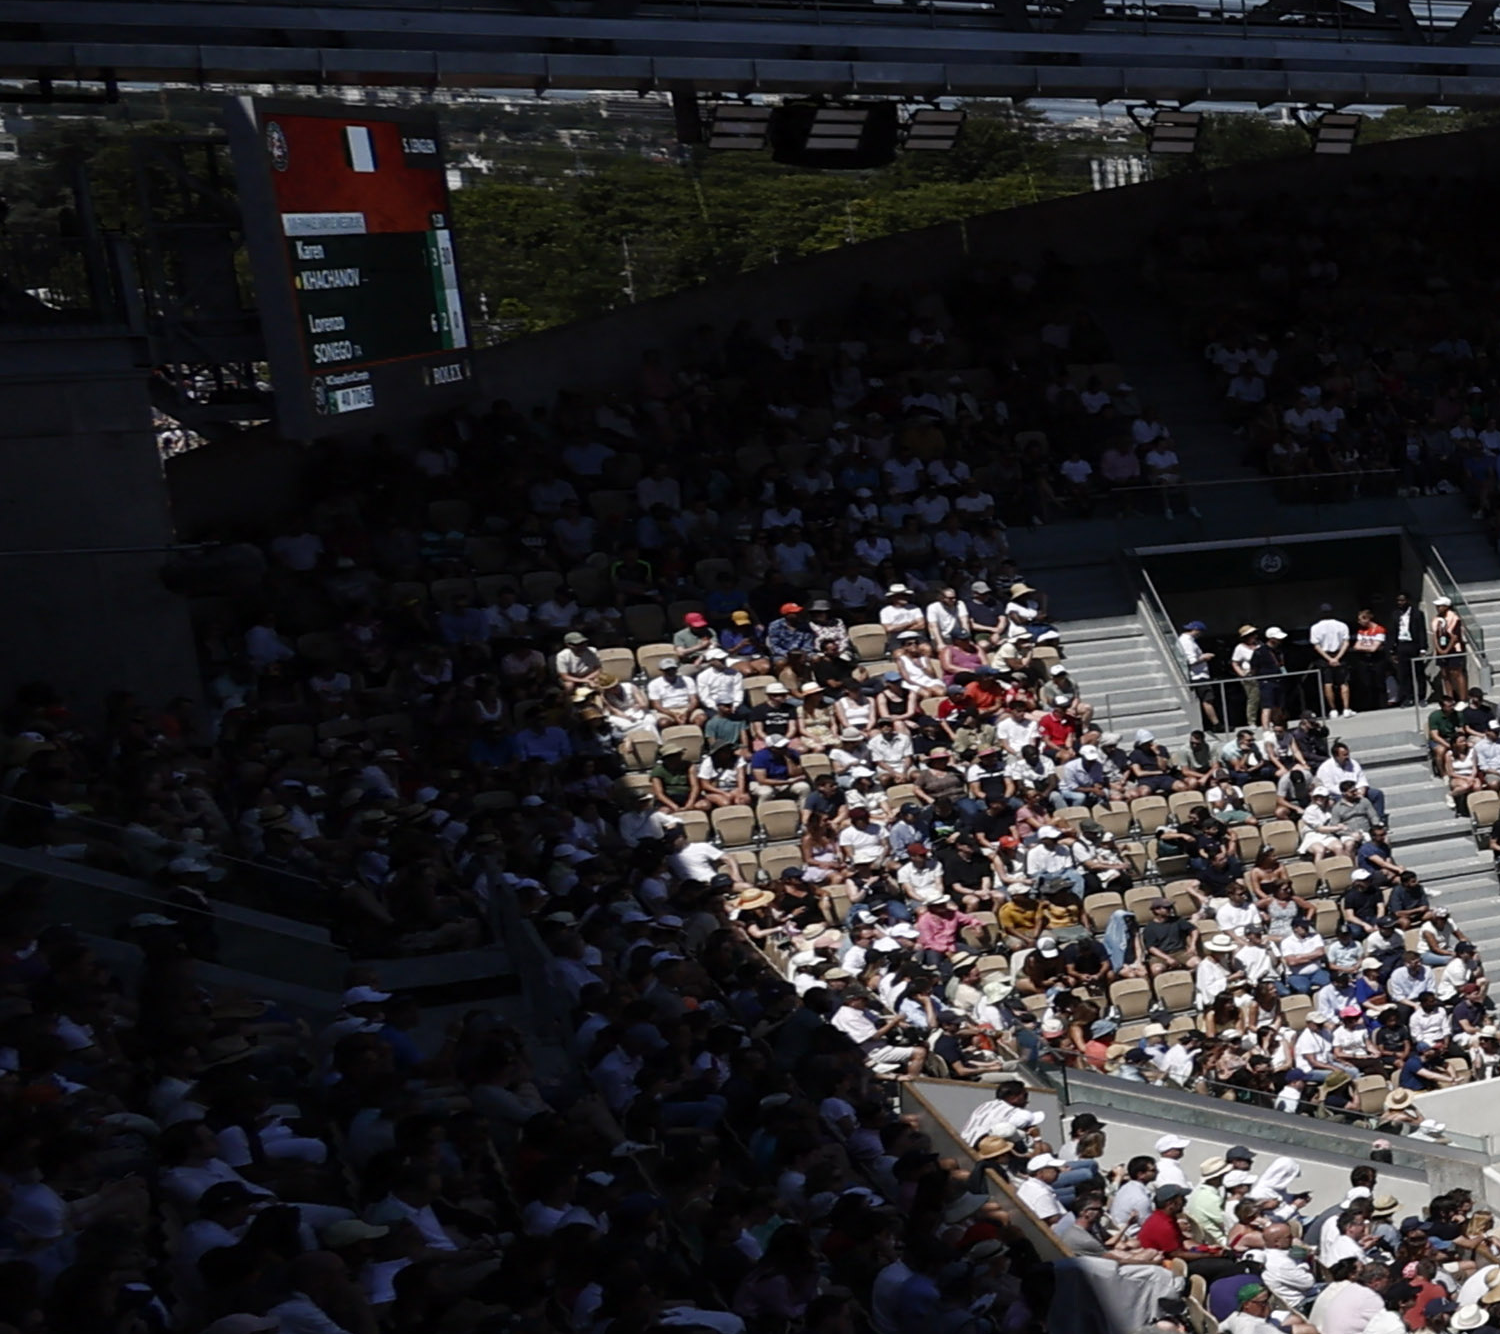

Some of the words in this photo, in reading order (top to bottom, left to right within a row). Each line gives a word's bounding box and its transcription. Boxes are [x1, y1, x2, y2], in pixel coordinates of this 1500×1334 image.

[296, 240, 324, 260] Karen
[301, 268, 360, 291] KHACHANOV
[308, 313, 345, 334] Lorenzo
[441, 311, 449, 332] 2
[314, 340, 352, 364] SONEGO
[433, 363, 462, 384] ROLEX
